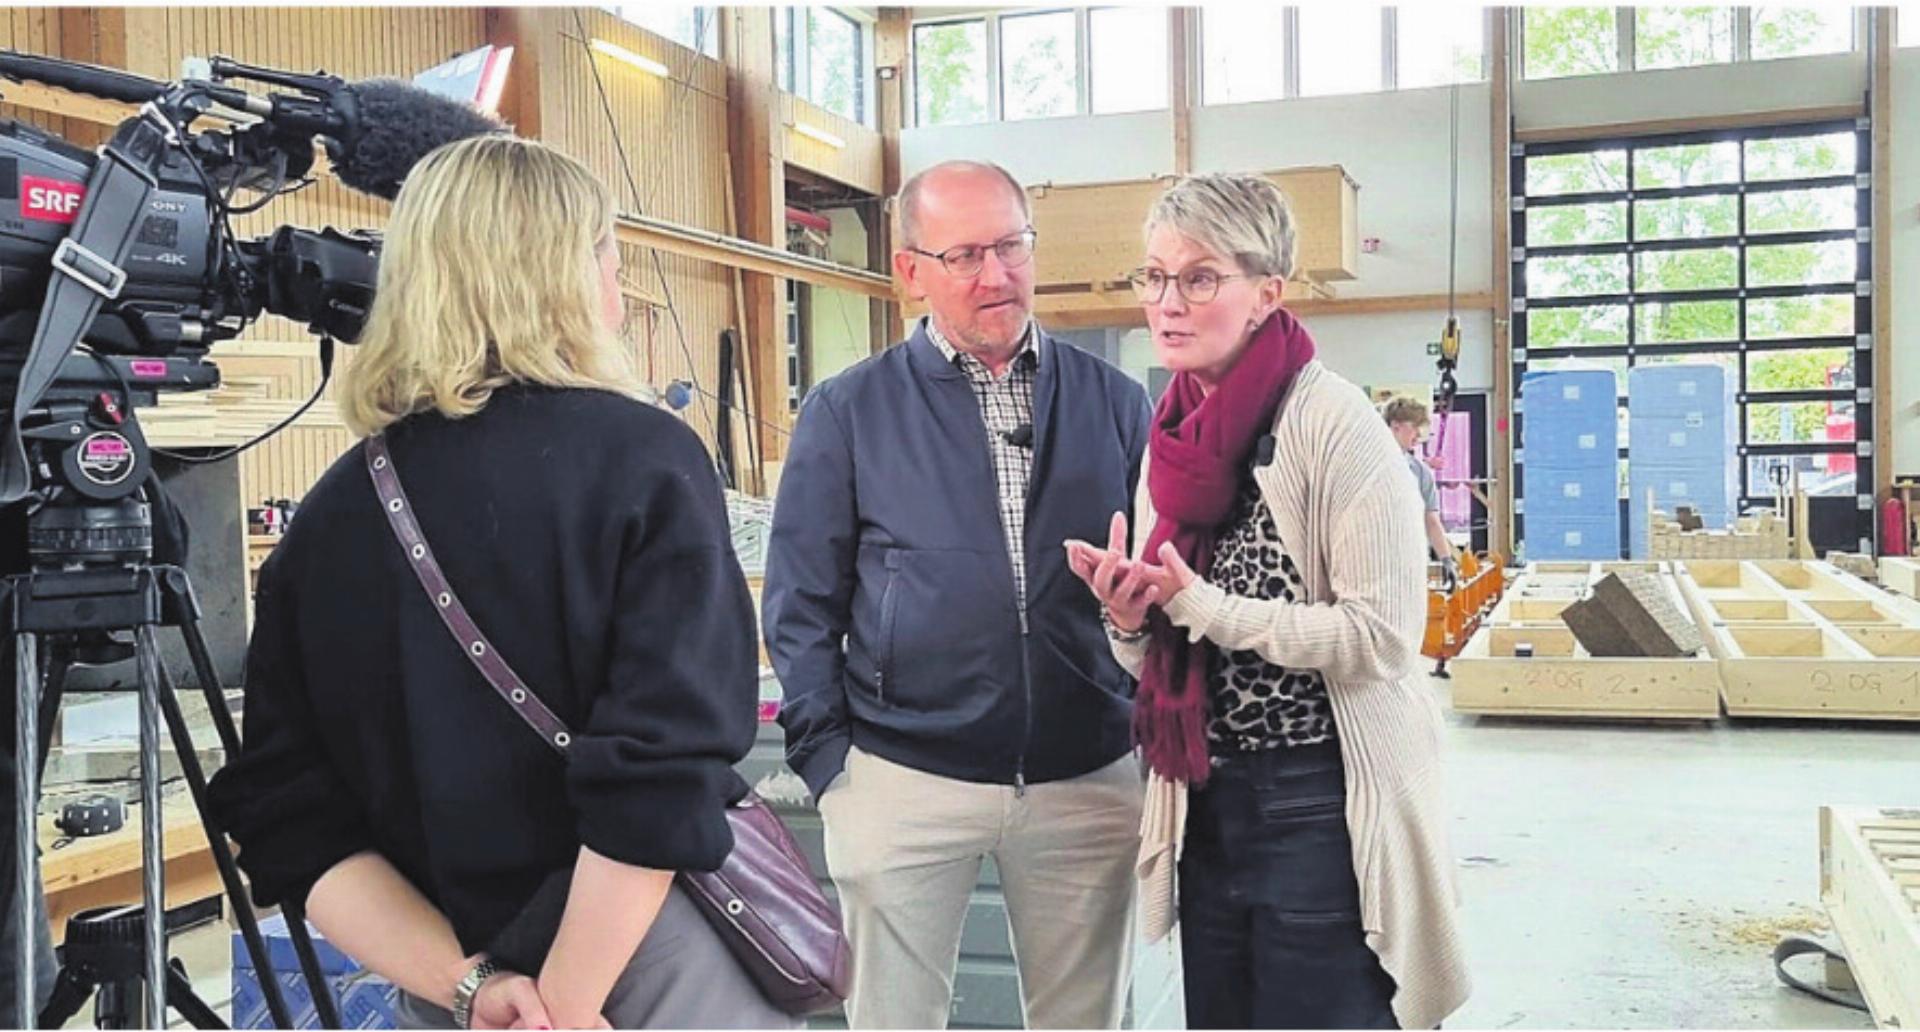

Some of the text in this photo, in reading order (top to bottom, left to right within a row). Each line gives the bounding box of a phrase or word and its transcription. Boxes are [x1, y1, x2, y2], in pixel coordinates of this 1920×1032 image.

[28, 187, 80, 214] SRF
[151, 201, 187, 212] ONY
[155, 253, 187, 265] 4K
[1605, 672, 1628, 695] 2
[1810, 668, 1836, 693] 2
